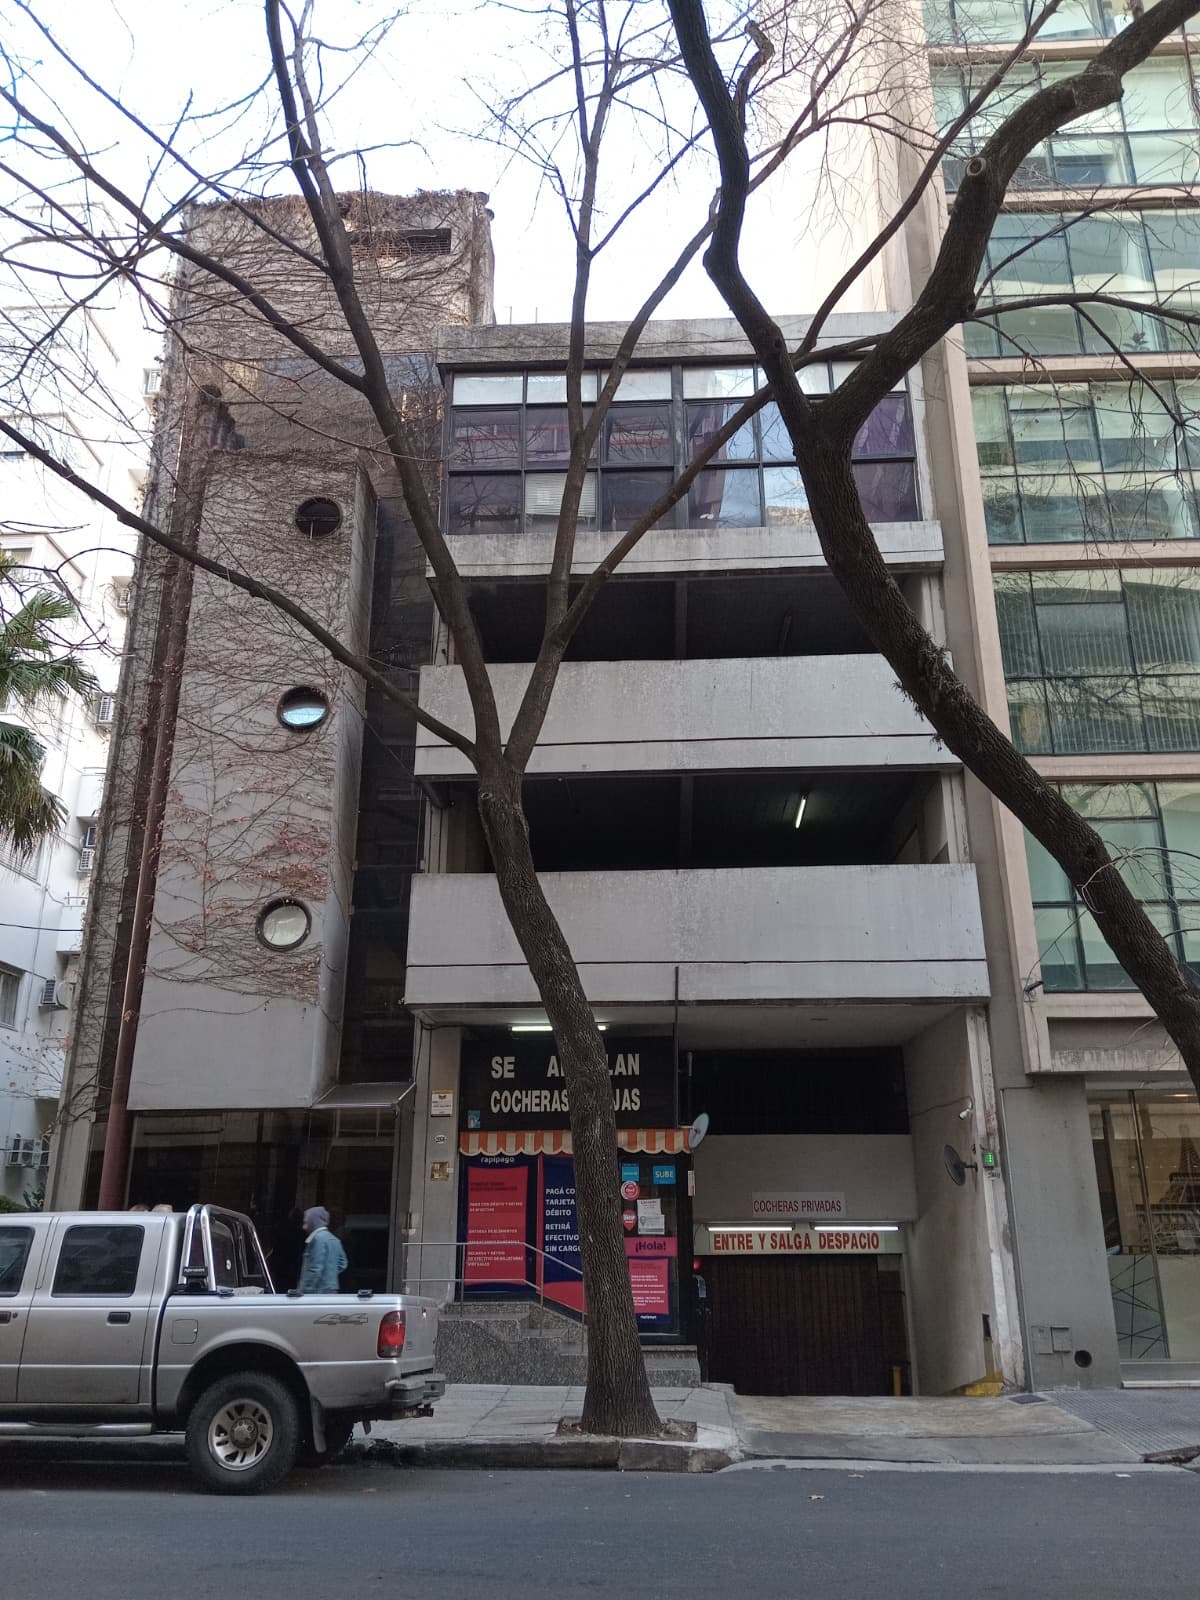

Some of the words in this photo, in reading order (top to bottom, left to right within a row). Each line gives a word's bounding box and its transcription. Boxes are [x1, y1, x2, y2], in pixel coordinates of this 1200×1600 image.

[491, 1056, 515, 1079] SE
[546, 1053, 640, 1077] ALAN
[490, 1090, 570, 1113] COCHERAS
[480, 1156, 515, 1165] rapipago
[655, 1170, 674, 1178] SUBE
[545, 1186, 564, 1195] PAGÁ
[545, 1198, 576, 1206] TARJETA
[753, 1200, 799, 1213] COCHERAS
[801, 1200, 842, 1212] PRIVADAS
[545, 1207, 572, 1216] DÉBITO
[545, 1221, 571, 1230] RETIRÁ
[713, 1233, 753, 1251] ENTRE
[758, 1233, 766, 1250] Y
[770, 1233, 812, 1250] SALGA
[818, 1232, 880, 1250] DESPACIO
[635, 1241, 667, 1253] ¡Hola!
